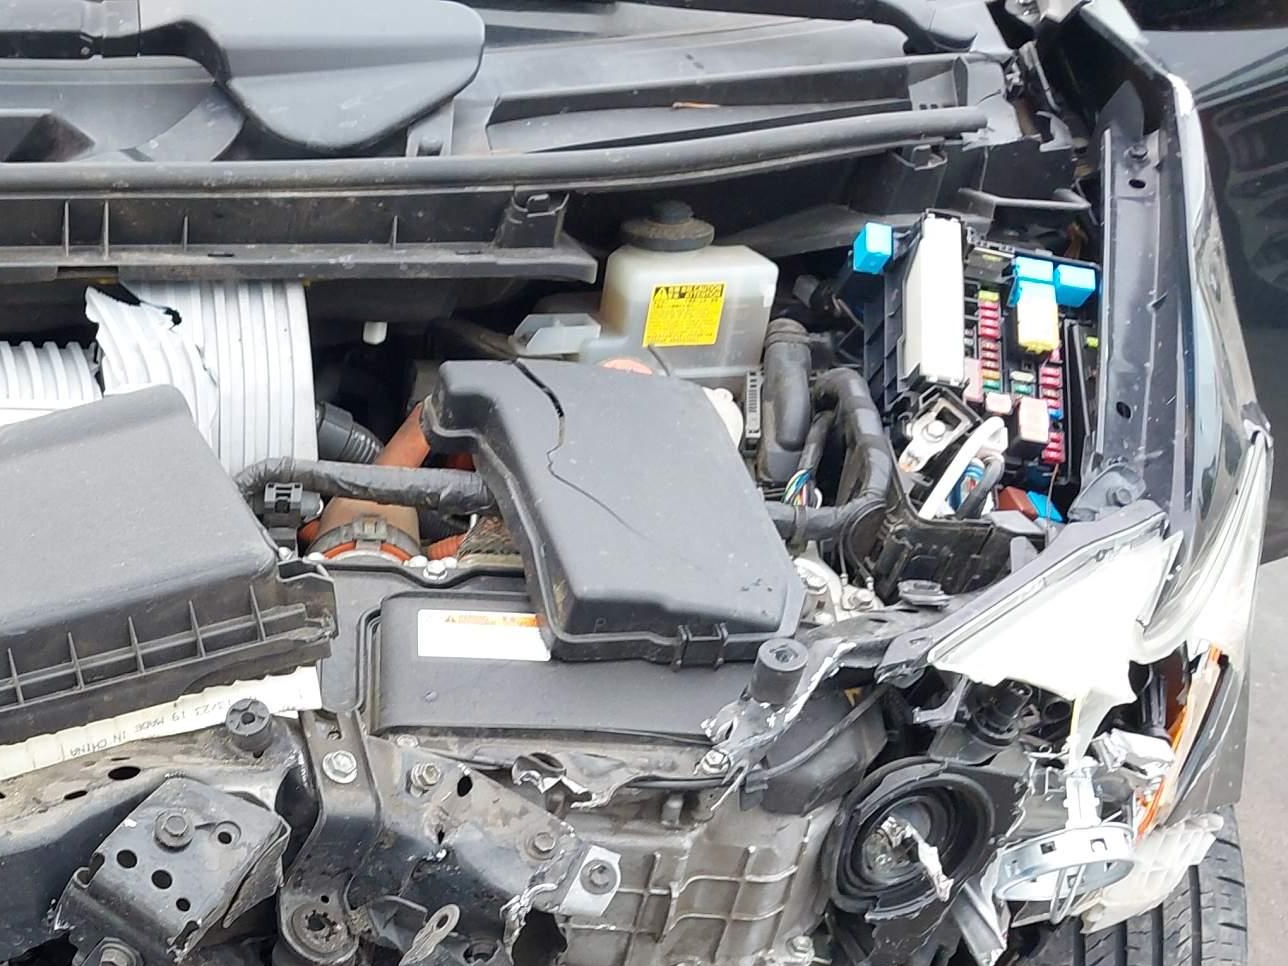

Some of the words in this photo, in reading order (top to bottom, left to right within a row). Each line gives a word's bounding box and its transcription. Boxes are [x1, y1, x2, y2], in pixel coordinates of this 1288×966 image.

[135, 716, 165, 732] MADE
[113, 730, 126, 743] IN
[70, 738, 108, 757] CHINA
